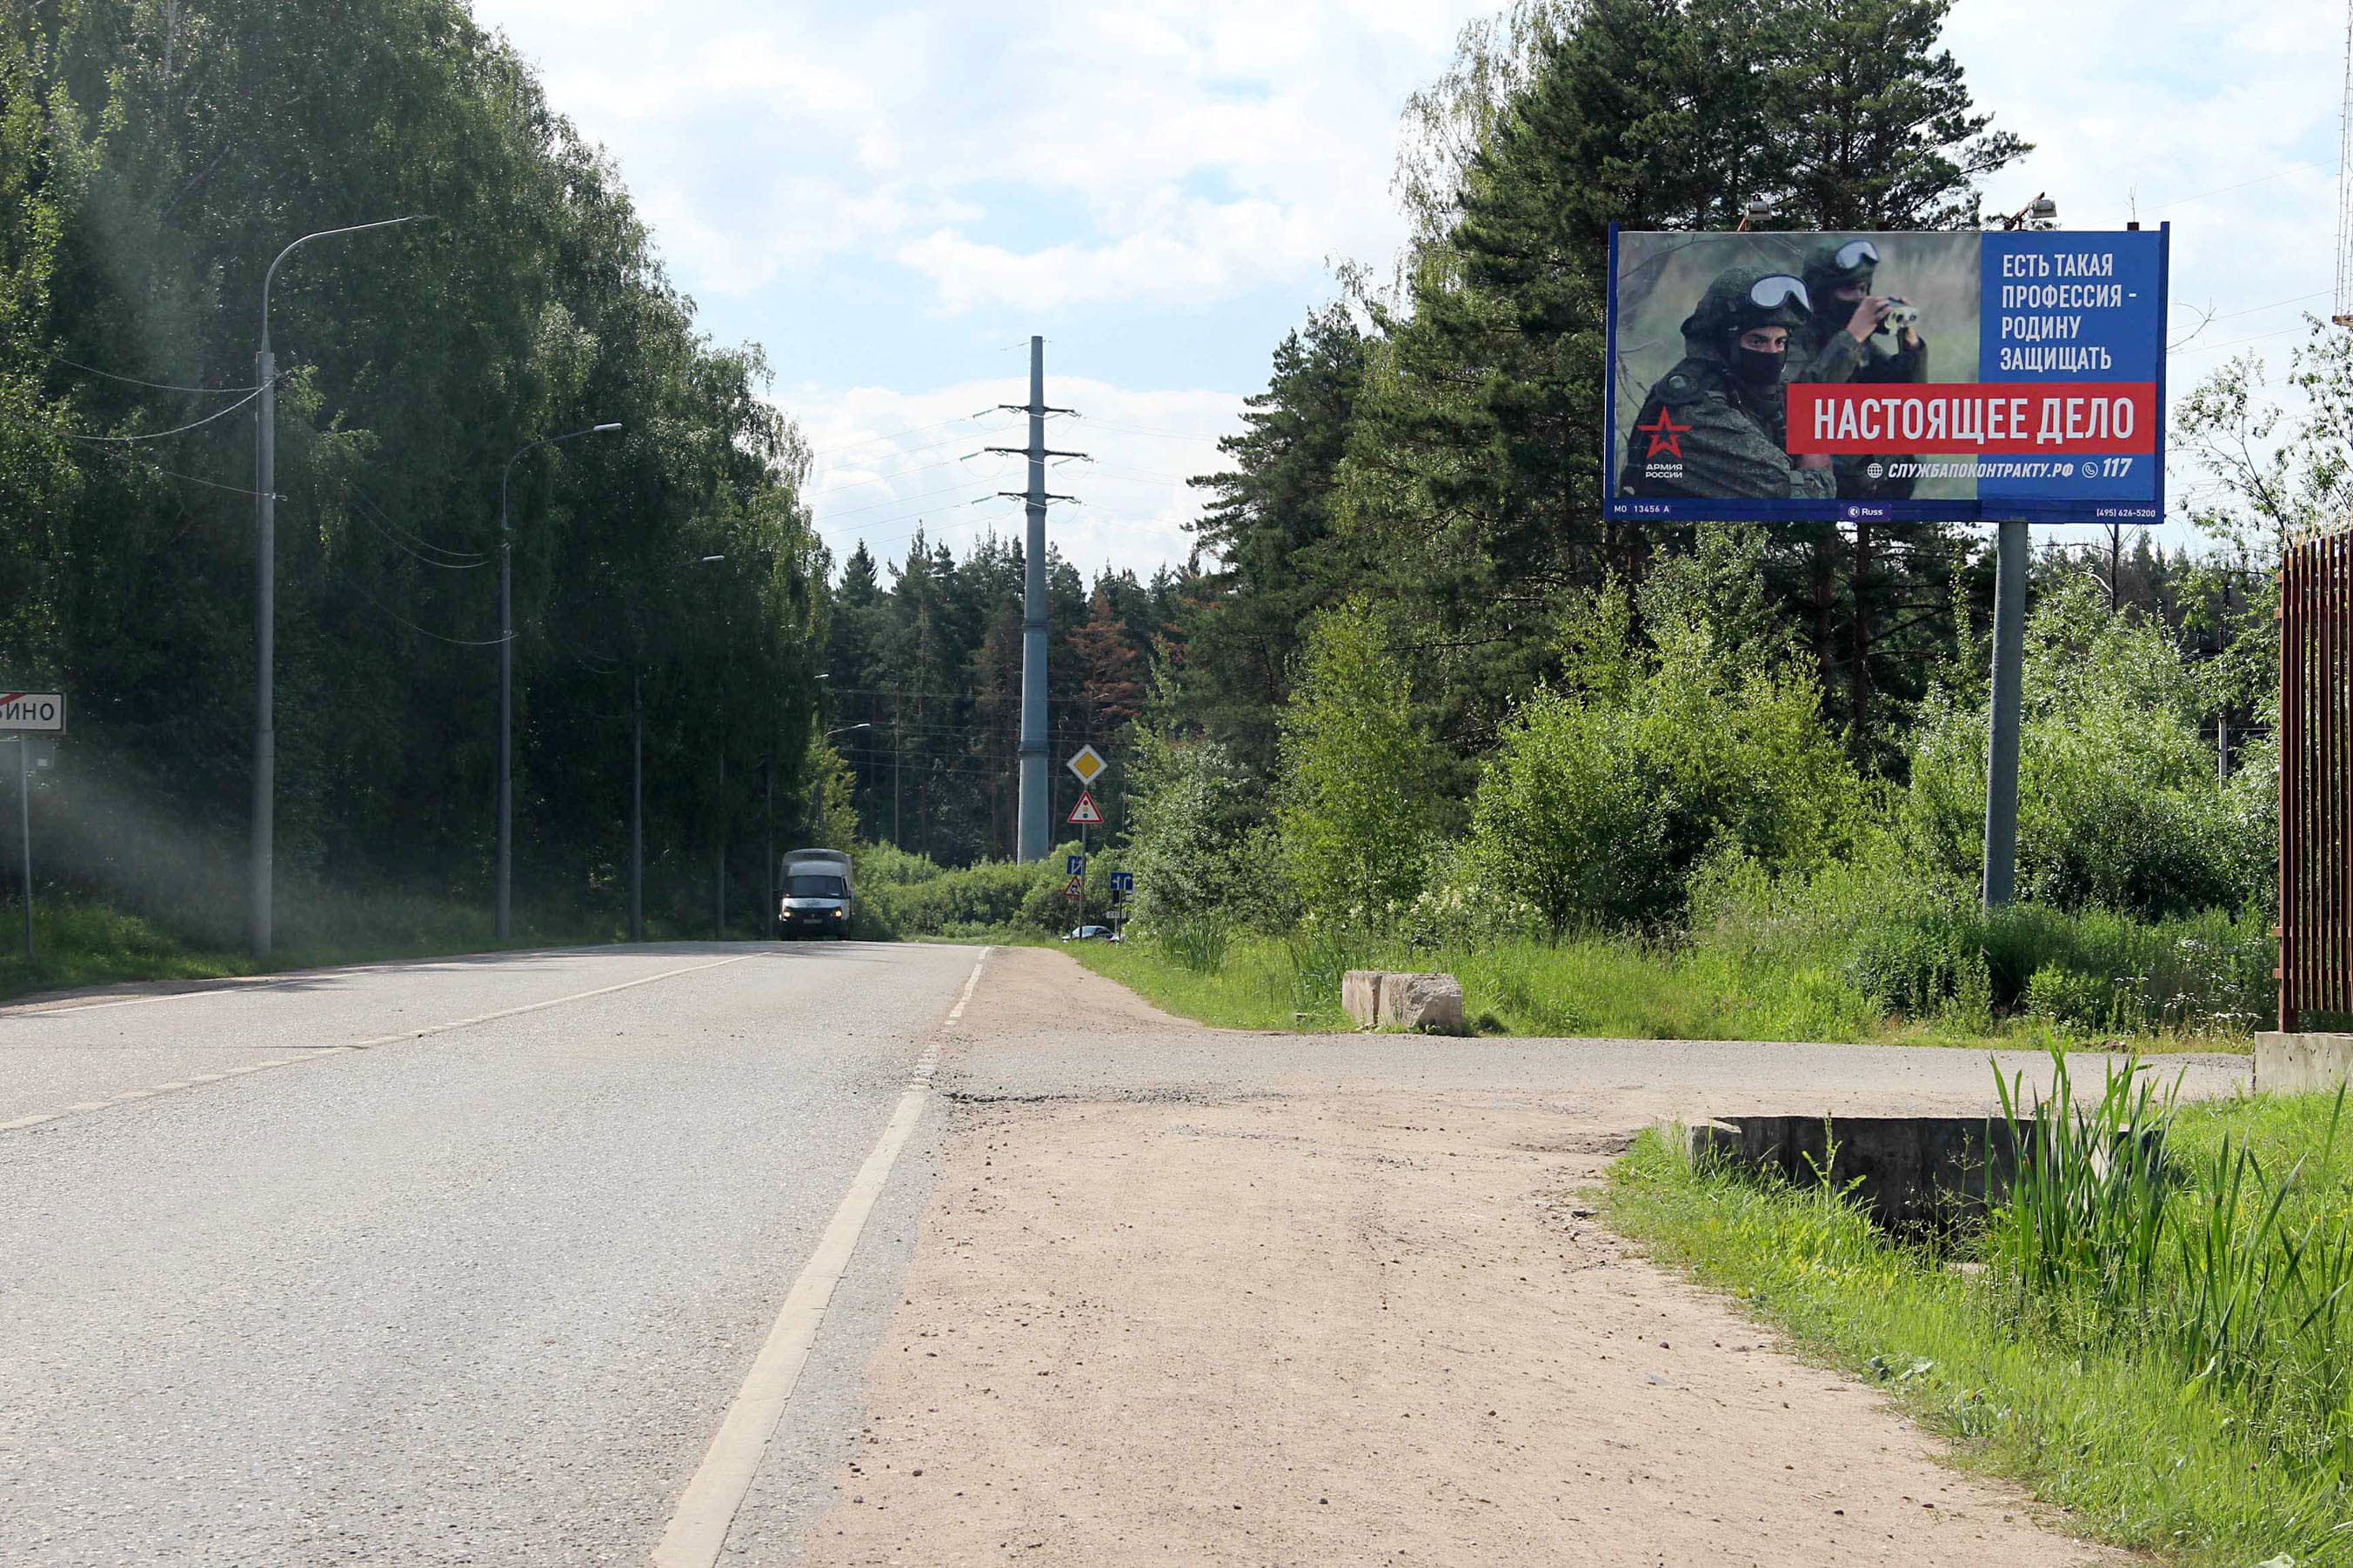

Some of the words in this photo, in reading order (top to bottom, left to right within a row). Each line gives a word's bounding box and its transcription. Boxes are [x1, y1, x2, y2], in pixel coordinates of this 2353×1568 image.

[2002, 253, 2050, 277] ЕСТЬ
[2054, 252, 2114, 277] ТАКАЯ
[2002, 284, 2122, 309] ПРОФЕССИЯ
[2001, 315, 2082, 342] РОДИНУ
[2000, 346, 2112, 373] ЗАЩИЩАТЬ
[1814, 397, 2029, 445] НАСТОЯЩЕЕ
[2036, 397, 2135, 445] ДЕЛО
[1888, 463, 2075, 478] СЛУЖБАПОКОНТРАКТУ.РФ
[2102, 457, 2133, 477] 117
[2096, 509, 2116, 517] (495)
[2118, 509, 2156, 517] 626-5200
[0, 703, 55, 721] ИНО
